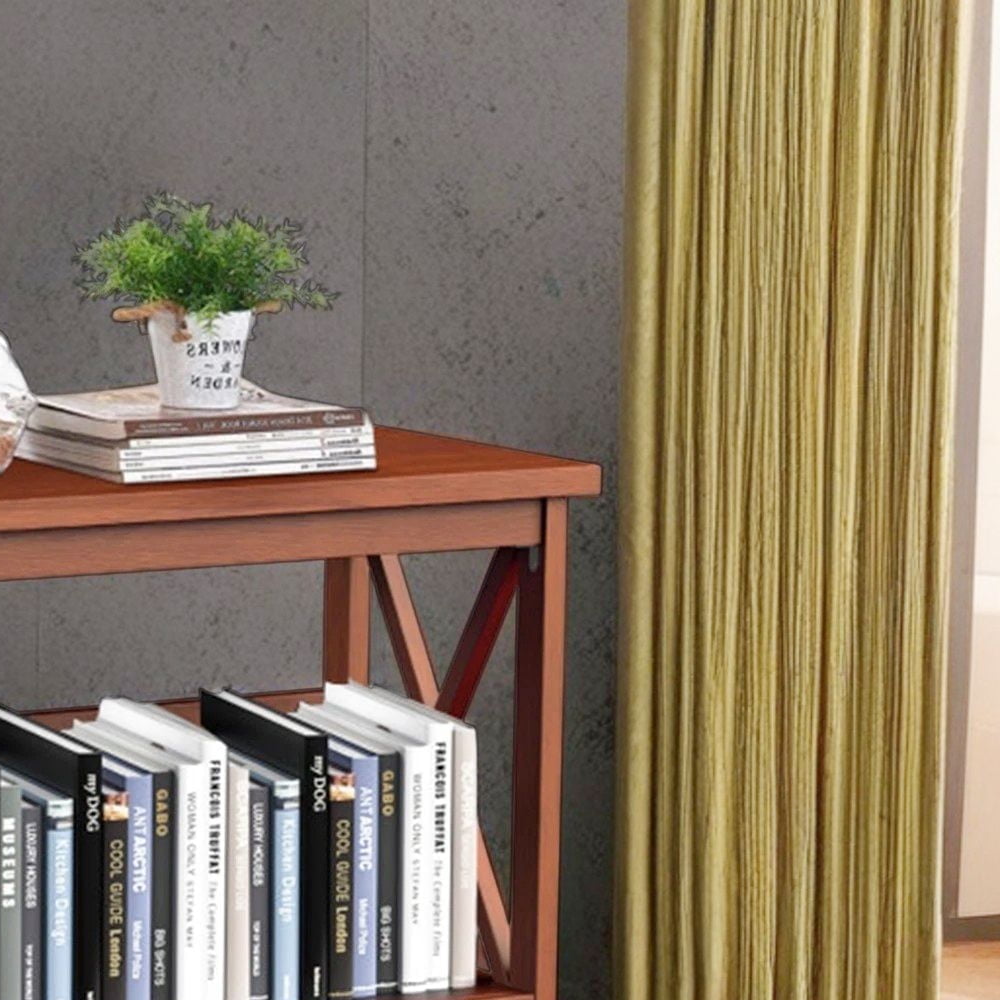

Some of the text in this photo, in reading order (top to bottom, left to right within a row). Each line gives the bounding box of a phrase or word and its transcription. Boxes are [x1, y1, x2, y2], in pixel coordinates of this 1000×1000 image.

[83, 773, 99, 832] my DOG
[156, 788, 169, 837] GABO
[310, 755, 326, 812] my DOG
[381, 769, 395, 817] GABO
[412, 773, 422, 820] WOMAN
[187, 792, 197, 840] WOMAN
[359, 786, 373, 871] ANTARCTIC
[412, 823, 422, 855] ONLY
[1, 817, 17, 908] MUSEUMS
[132, 806, 147, 892] ANTARCTIC
[186, 843, 197, 876] ONLY
[279, 819, 295, 922] Kitchen Design
[51, 839, 68, 946] Kitchen Design
[109, 839, 123, 978] COOL GUIDE London
[336, 820, 350, 954] COOL GUIDE London
